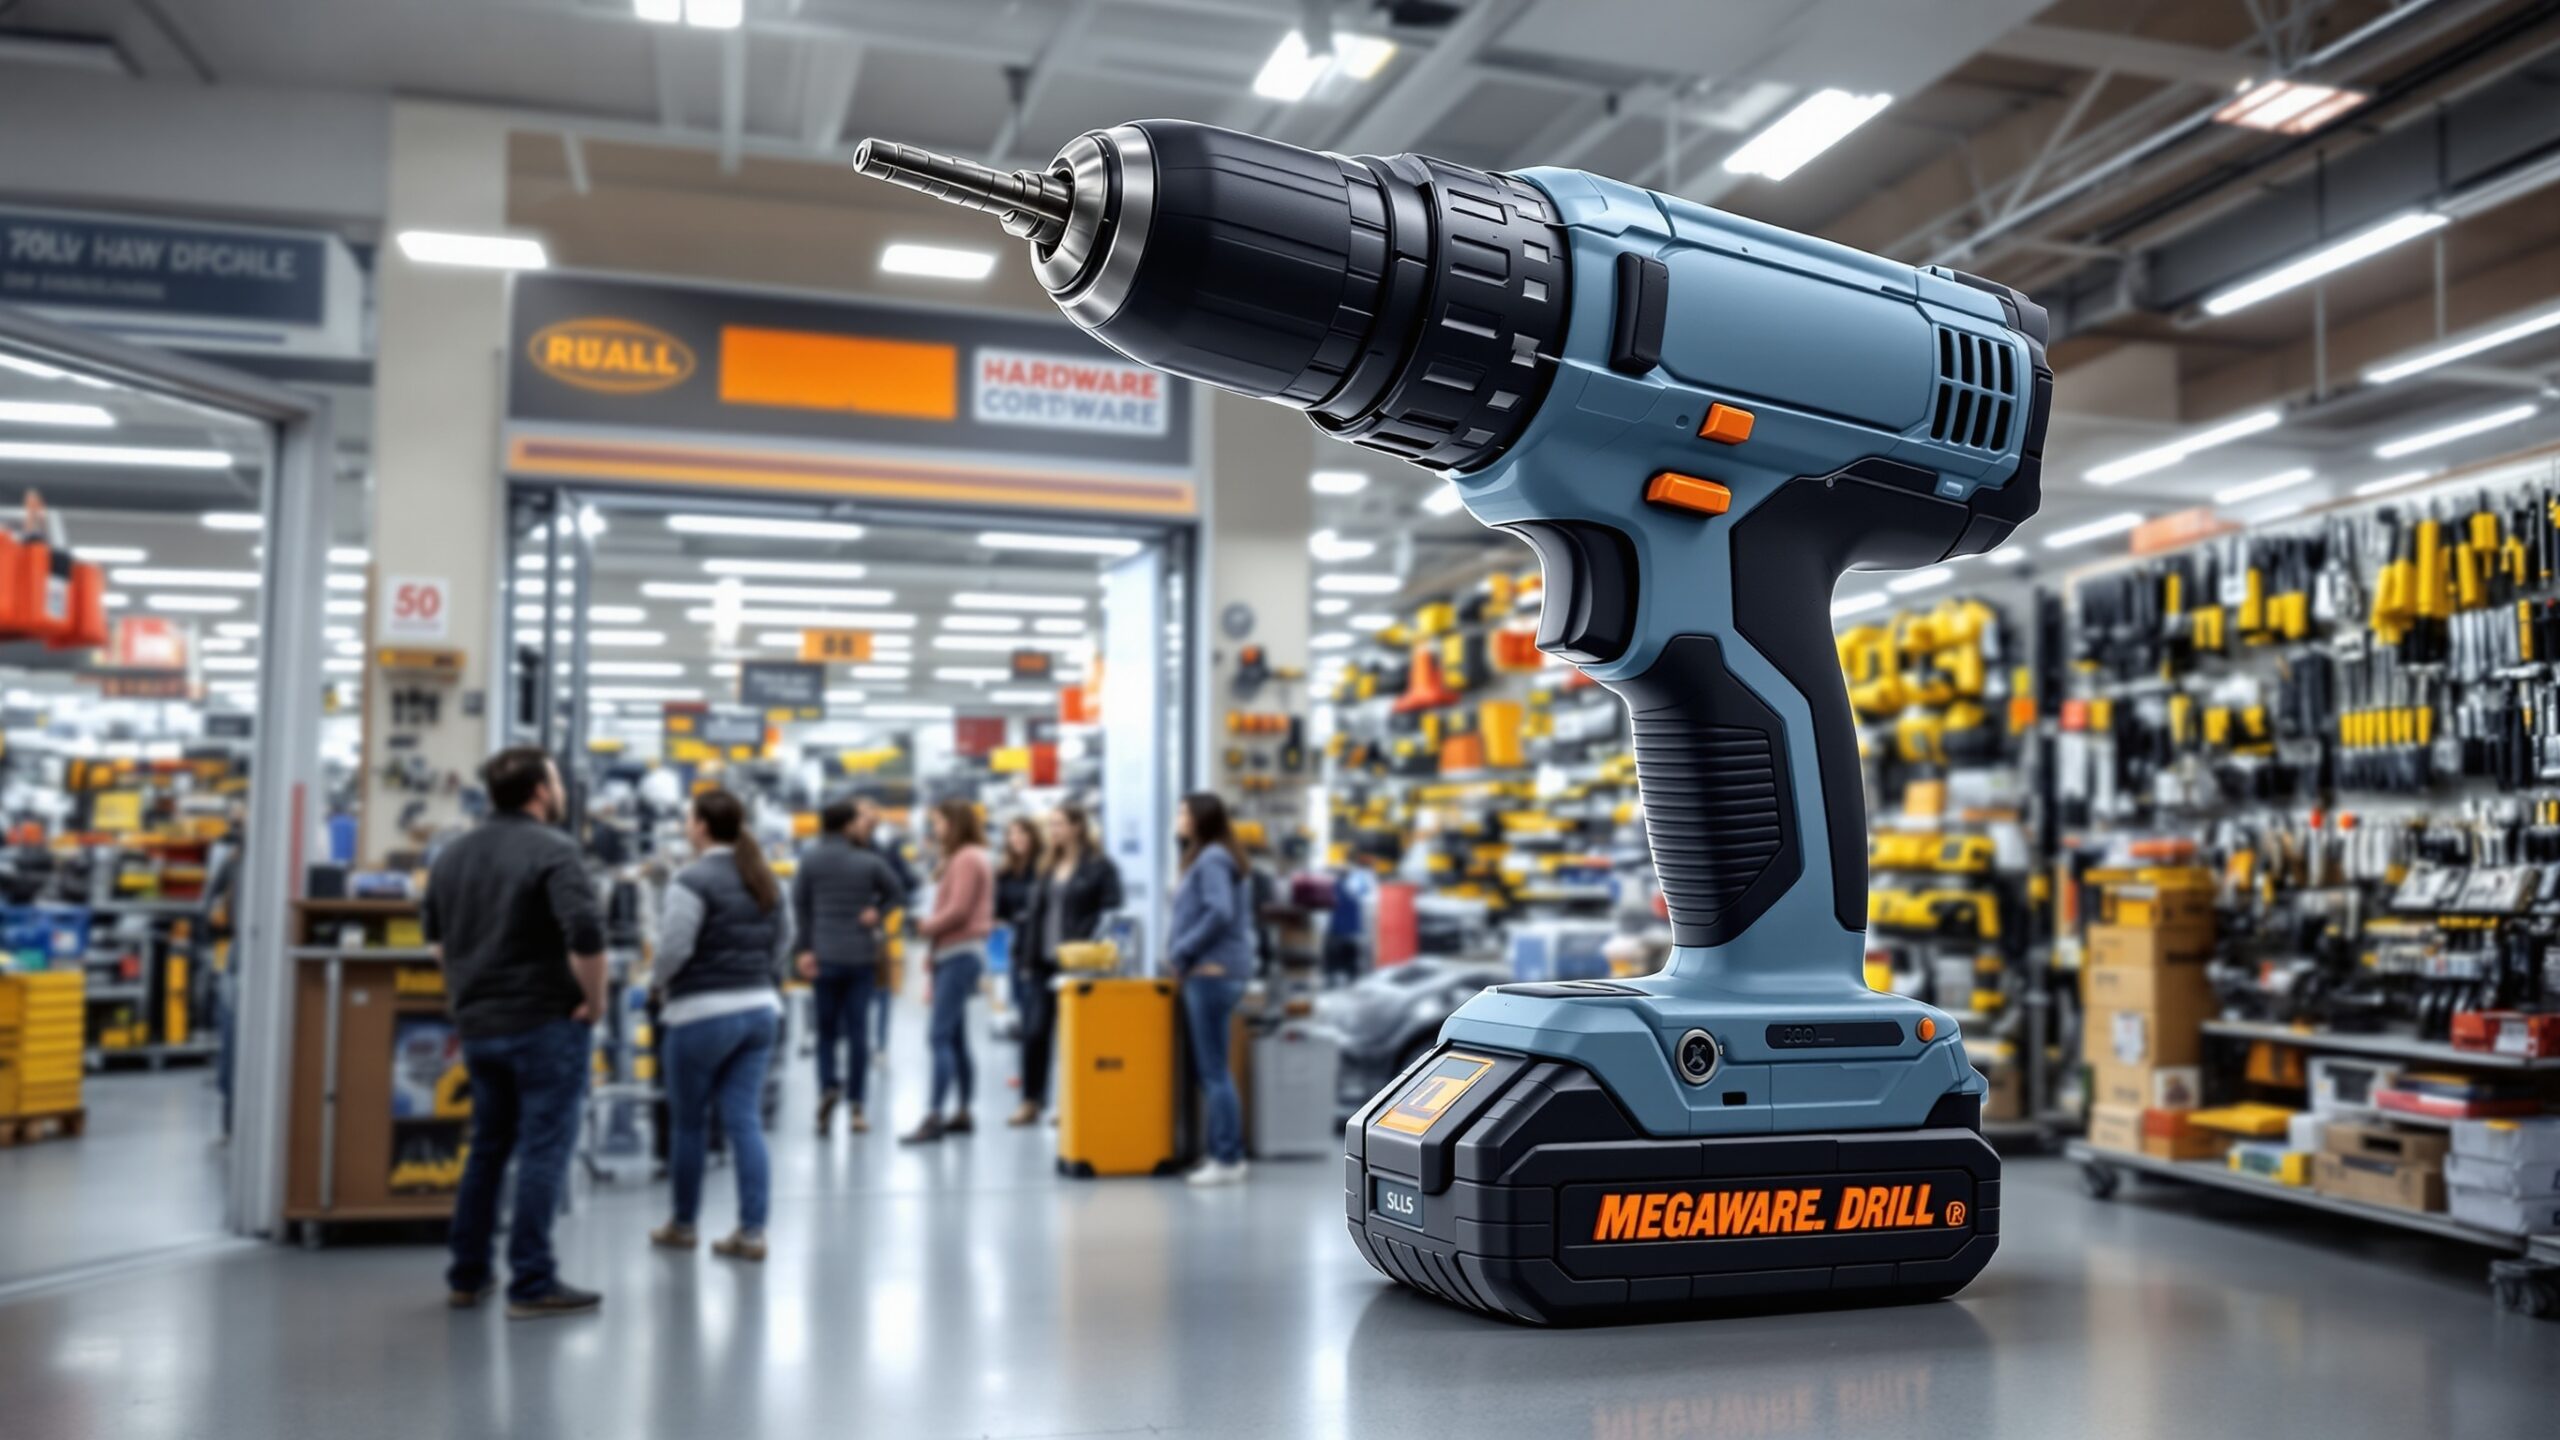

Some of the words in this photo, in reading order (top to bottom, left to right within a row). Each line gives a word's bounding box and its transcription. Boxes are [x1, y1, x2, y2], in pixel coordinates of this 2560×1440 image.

[546, 335, 679, 376] RUALL
[984, 359, 1160, 400] HARDWARE
[394, 584, 441, 619] 50
[1834, 1184, 1936, 1230] DRILL
